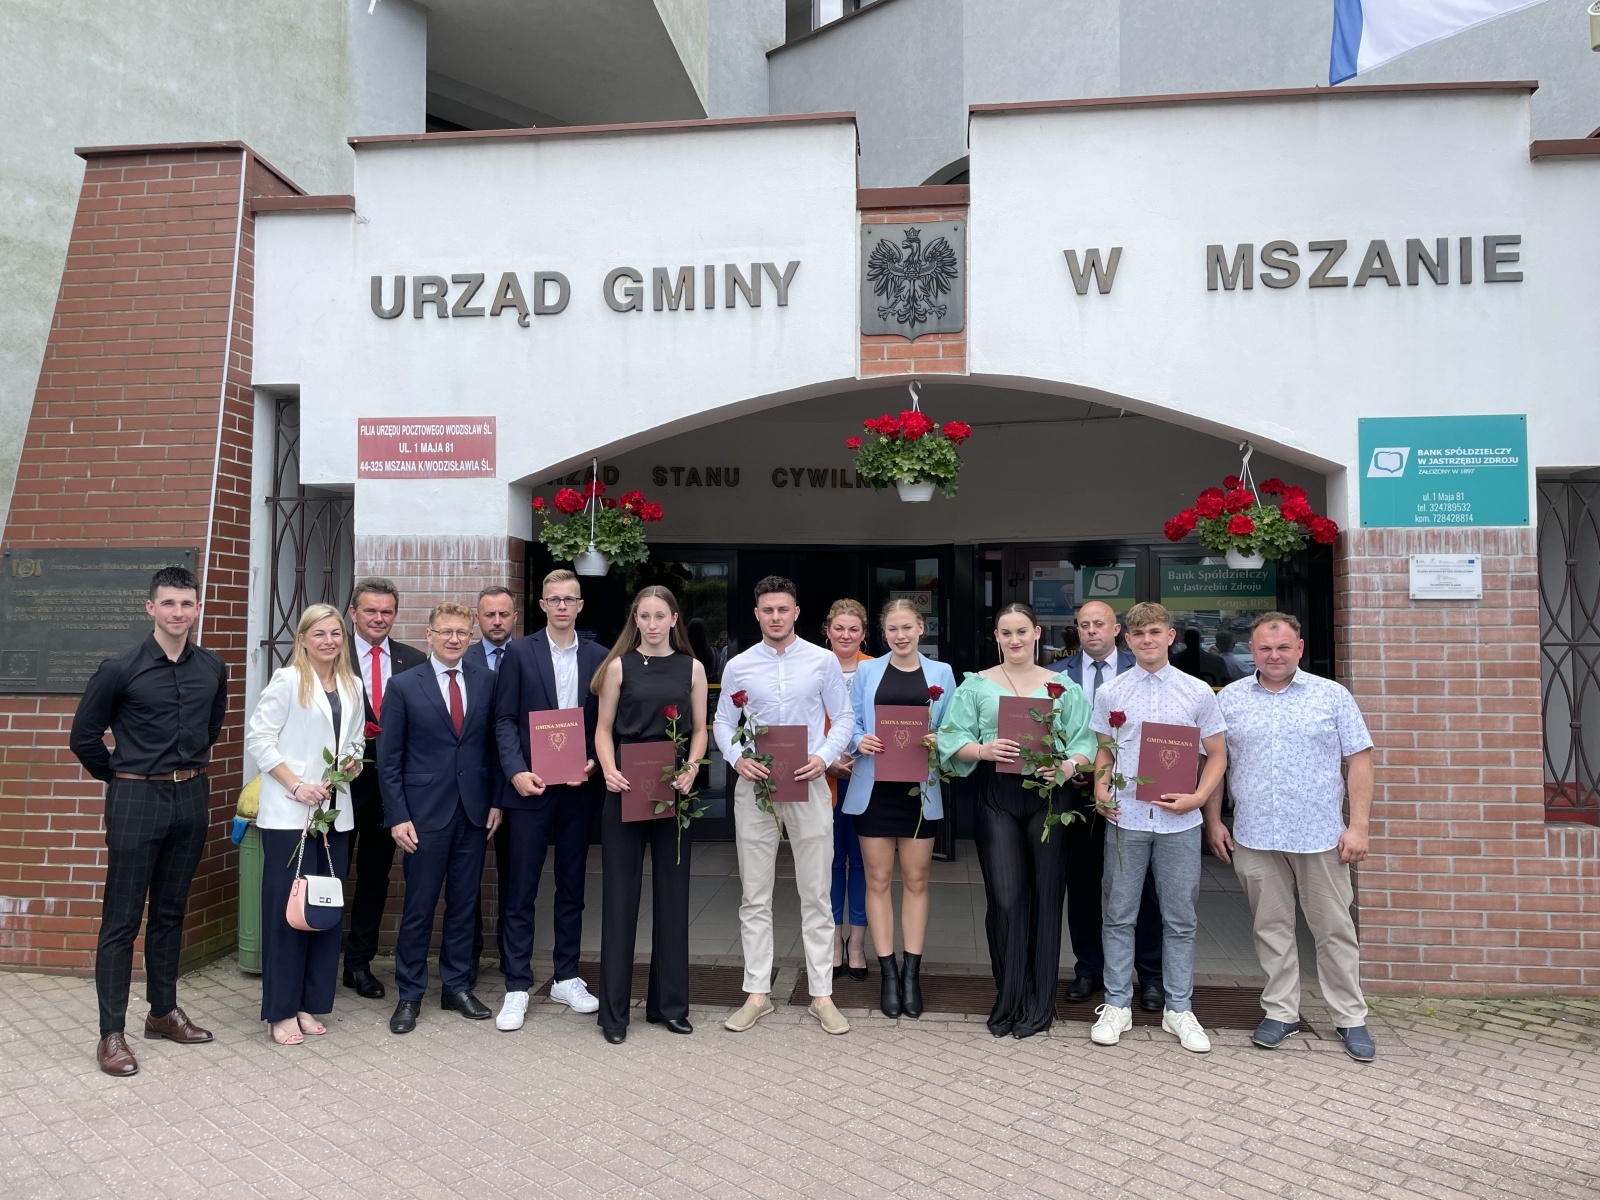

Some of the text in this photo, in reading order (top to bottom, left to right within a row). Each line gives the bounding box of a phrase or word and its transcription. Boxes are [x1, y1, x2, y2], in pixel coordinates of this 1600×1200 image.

[1063, 234, 1524, 295] W MSZANIE
[370, 260, 801, 328] URZĄD GMINY
[360, 422, 493, 438] FILIA URZĘDU POCZTOWEGO WODZISŁAW ŚL.
[399, 442, 454, 453] UL. 1 MAJA 81
[1445, 446, 1512, 456] SPÓŁDZIELCZY
[360, 458, 493, 472] 44-325 MSZANA K/WODZISŁAWIA ŚL.
[1428, 457, 1482, 466] JASTRZĘBIU
[1483, 456, 1519, 464] ZDROJU
[652, 465, 740, 487] STANU
[771, 467, 897, 489] CYWILN
[1422, 492, 1465, 502] ul. 1 Maja 81
[1417, 503, 1471, 512] tel. 324789532
[1415, 513, 1474, 523] kom. 728428814
[1168, 569, 1269, 582] Bank Spółdzielczy
[1183, 582, 1228, 593] Jastrzębiu
[1230, 582, 1262, 592] Zdroju
[1217, 599, 1269, 609] Grupa BPS
[535, 721, 579, 731] GMINA MSZANA
[1146, 737, 1193, 748] GMINA MSZANA
